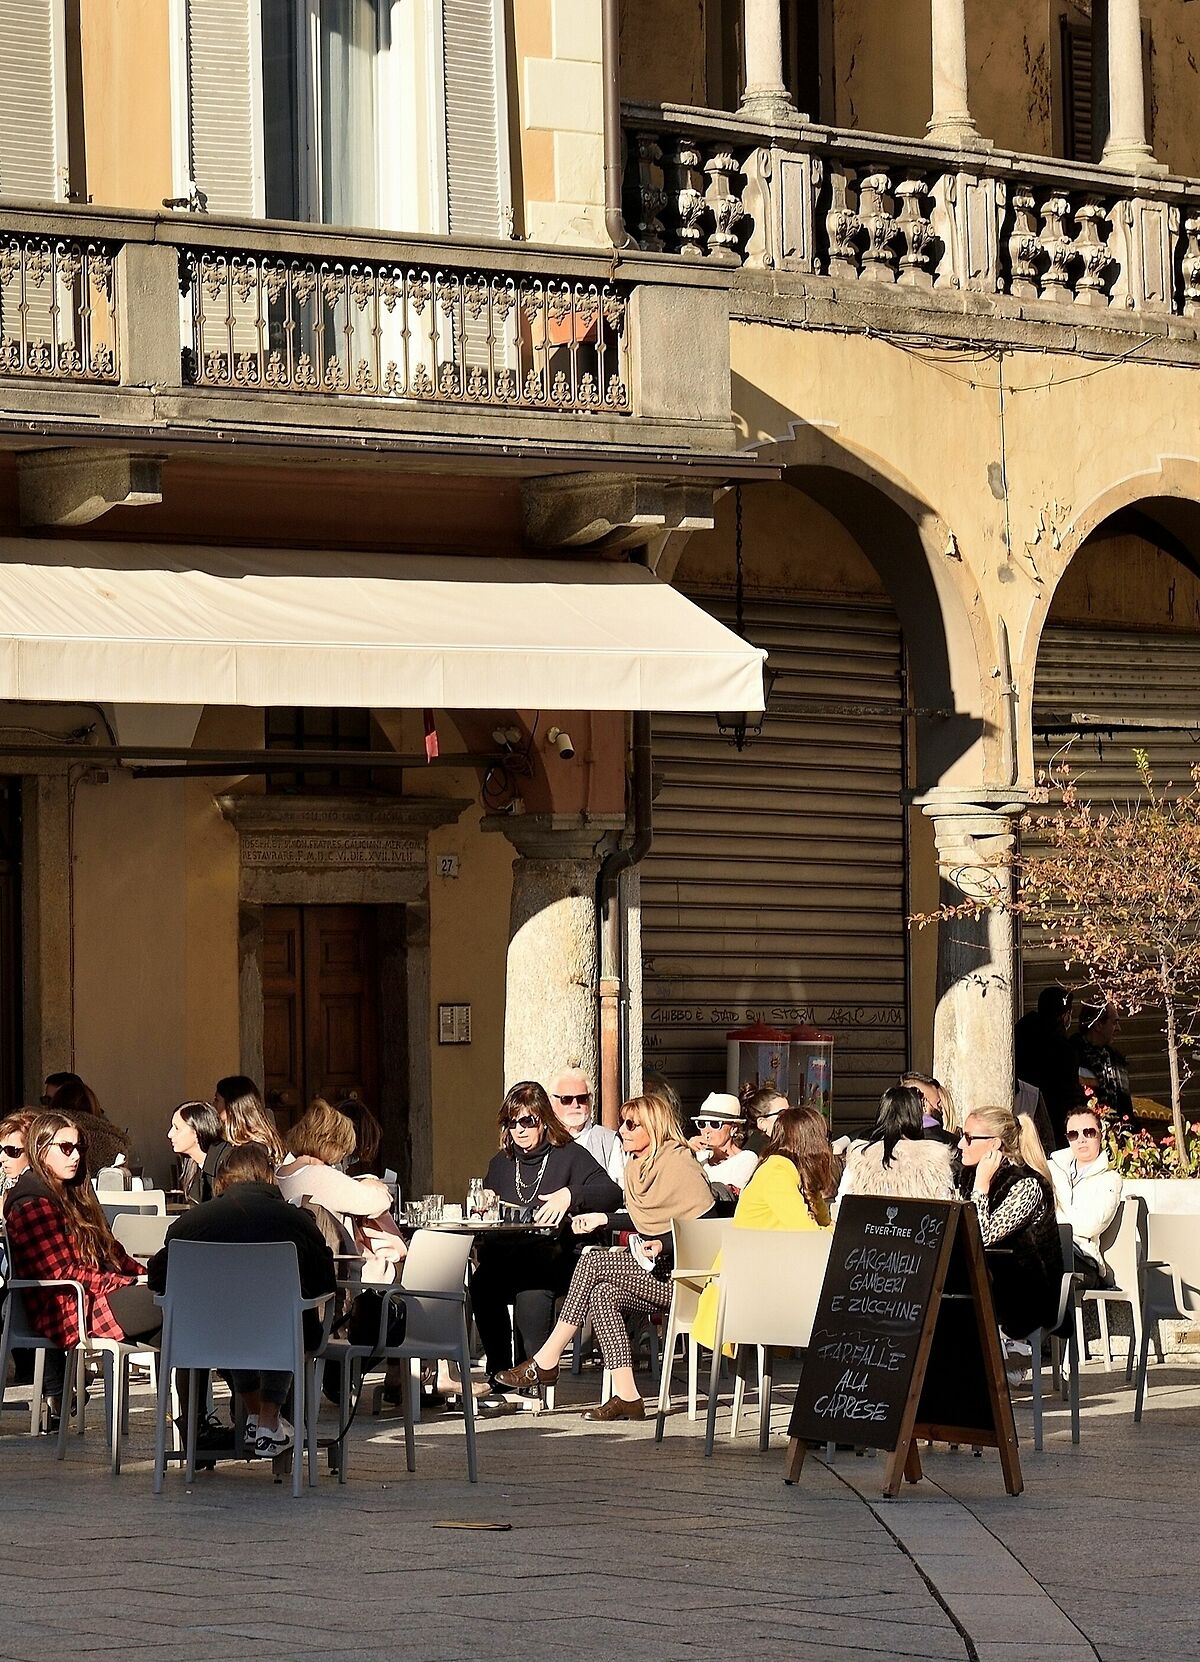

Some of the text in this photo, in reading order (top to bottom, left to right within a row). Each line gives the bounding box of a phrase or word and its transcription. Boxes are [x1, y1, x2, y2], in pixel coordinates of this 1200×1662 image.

[441, 859, 453, 872] 27
[651, 1008, 692, 1022] GHIBBO
[711, 1008, 740, 1023] STATO
[864, 1223, 912, 1238] FEVER-TREE
[844, 1248, 922, 1274] GARGANELLI
[850, 1273, 907, 1293] GAMBERI
[831, 1296, 922, 1321] E ZUCCHINE
[834, 1368, 869, 1393] ALLA
[814, 1395, 890, 1421] CAPRESE
